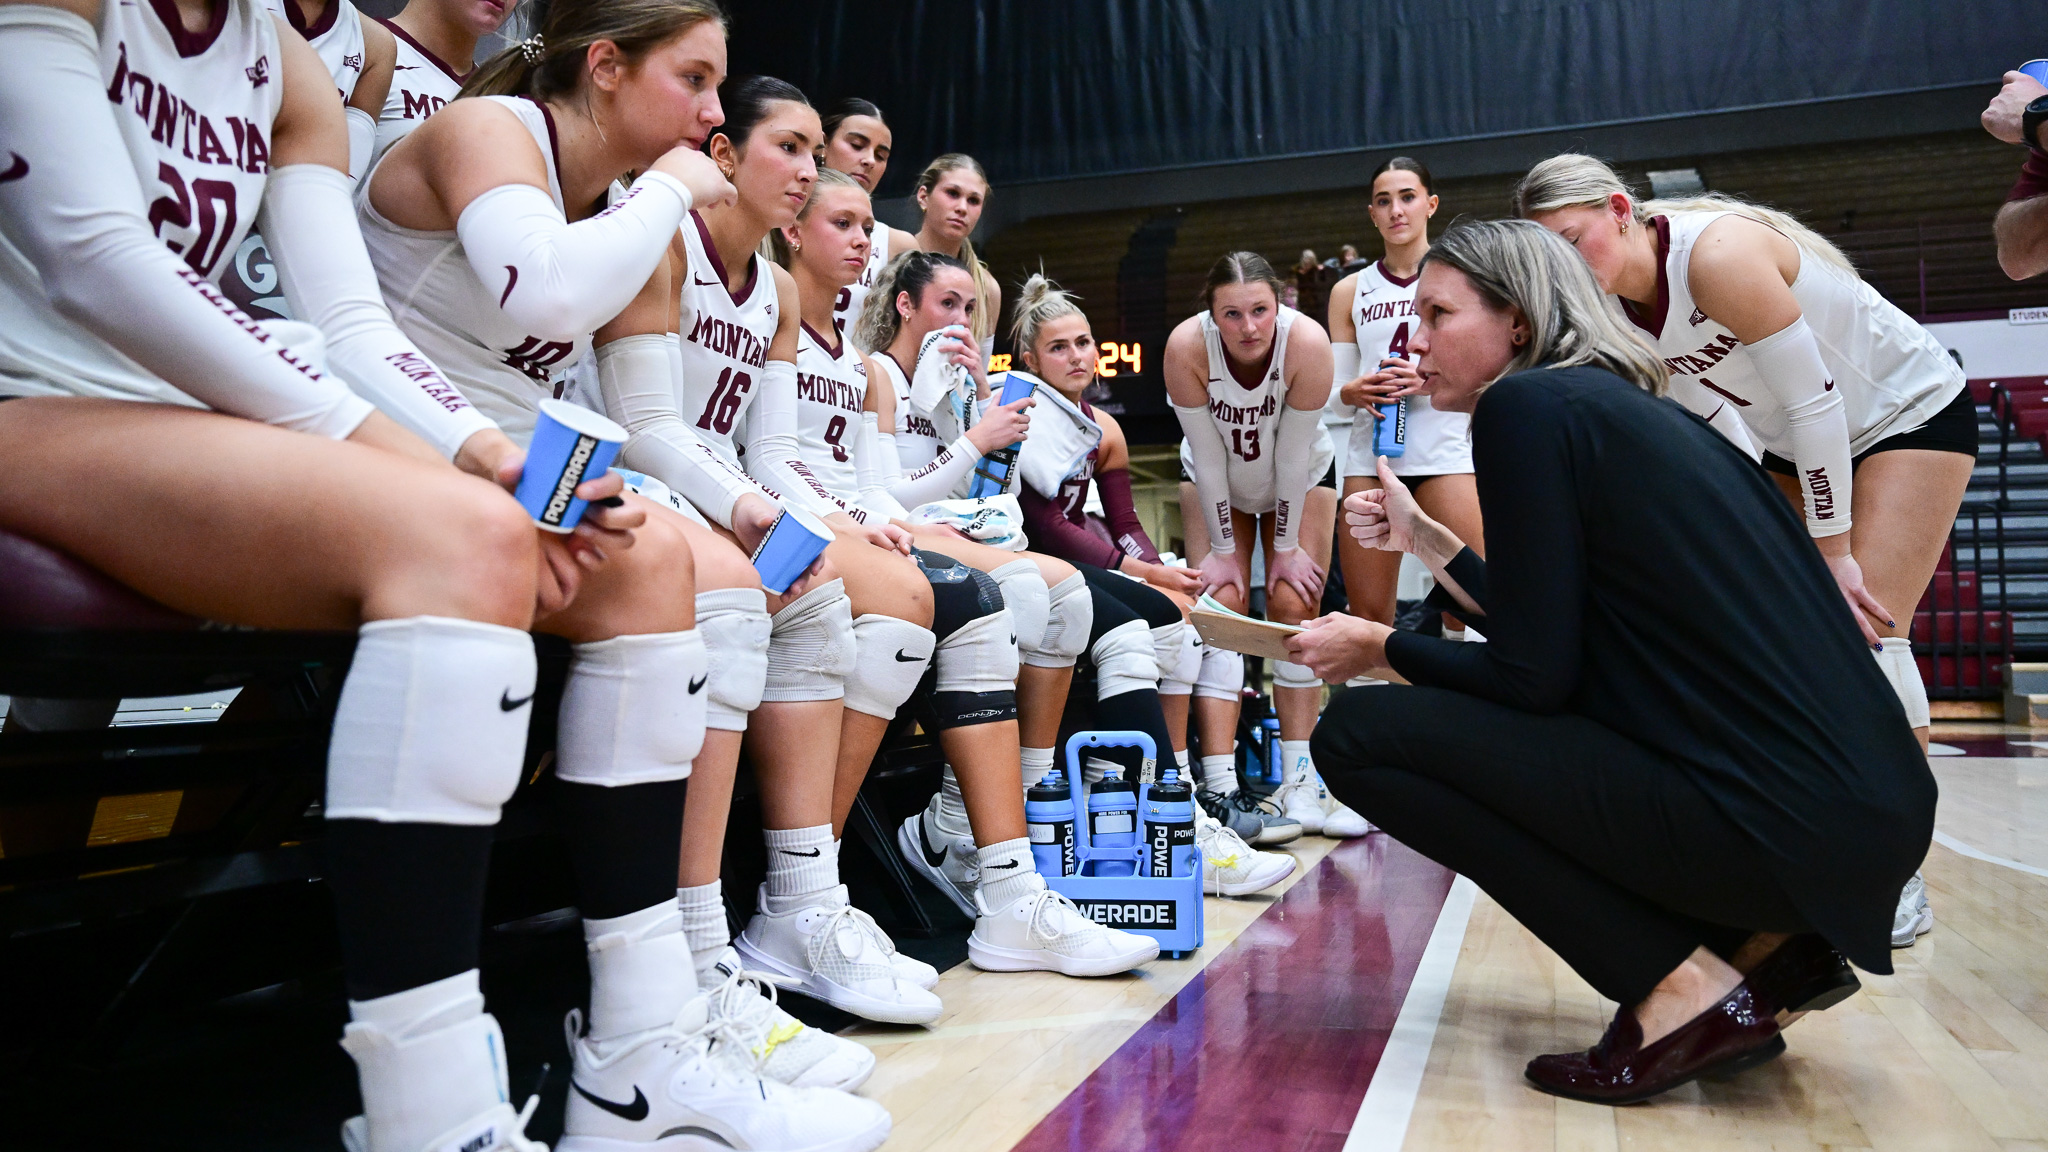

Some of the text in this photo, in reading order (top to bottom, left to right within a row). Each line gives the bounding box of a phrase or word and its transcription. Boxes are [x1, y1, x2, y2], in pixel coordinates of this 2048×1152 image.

[1361, 300, 1418, 326] MONTA
[687, 309, 770, 369] MONTAN
[1389, 322, 1410, 362] 4
[1663, 333, 1740, 376] NTANA
[695, 366, 752, 435] 16
[797, 372, 865, 414] MONTAN
[963, 388, 977, 433] POWERA
[824, 414, 849, 463] 9
[1397, 395, 1406, 444] POWERA
[1231, 428, 1261, 462] 13
[544, 435, 597, 523] POWERADE
[1806, 467, 1835, 520] MONTAN
[1062, 484, 1081, 520] 7
[1077, 904, 1170, 924] WERADE
